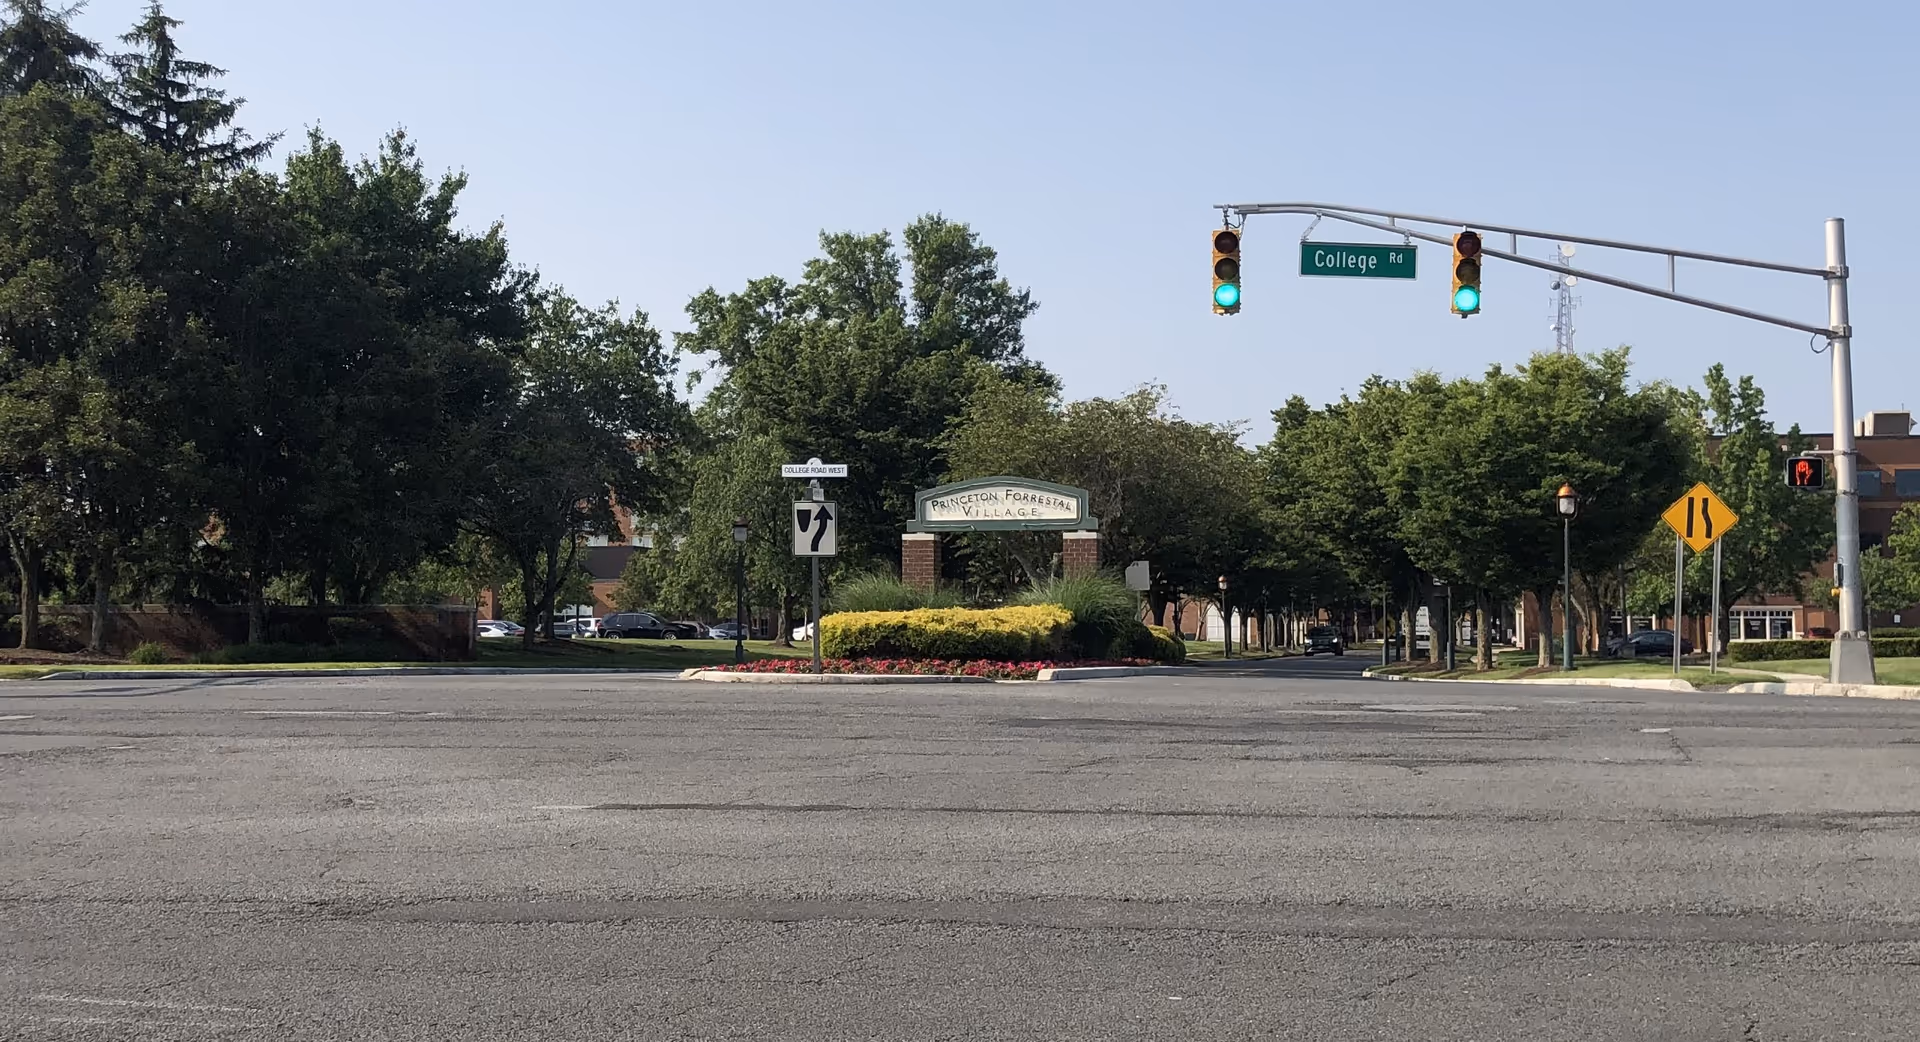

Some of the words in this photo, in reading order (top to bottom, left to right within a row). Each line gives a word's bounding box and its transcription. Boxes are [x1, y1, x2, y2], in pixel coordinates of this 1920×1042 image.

[1315, 249, 1377, 274] College
[1389, 252, 1403, 264] Rd
[784, 466, 810, 474] COLLEGE
[810, 466, 827, 474] ROAD
[828, 466, 845, 474] WEST
[962, 505, 1038, 517] VILLAGE
